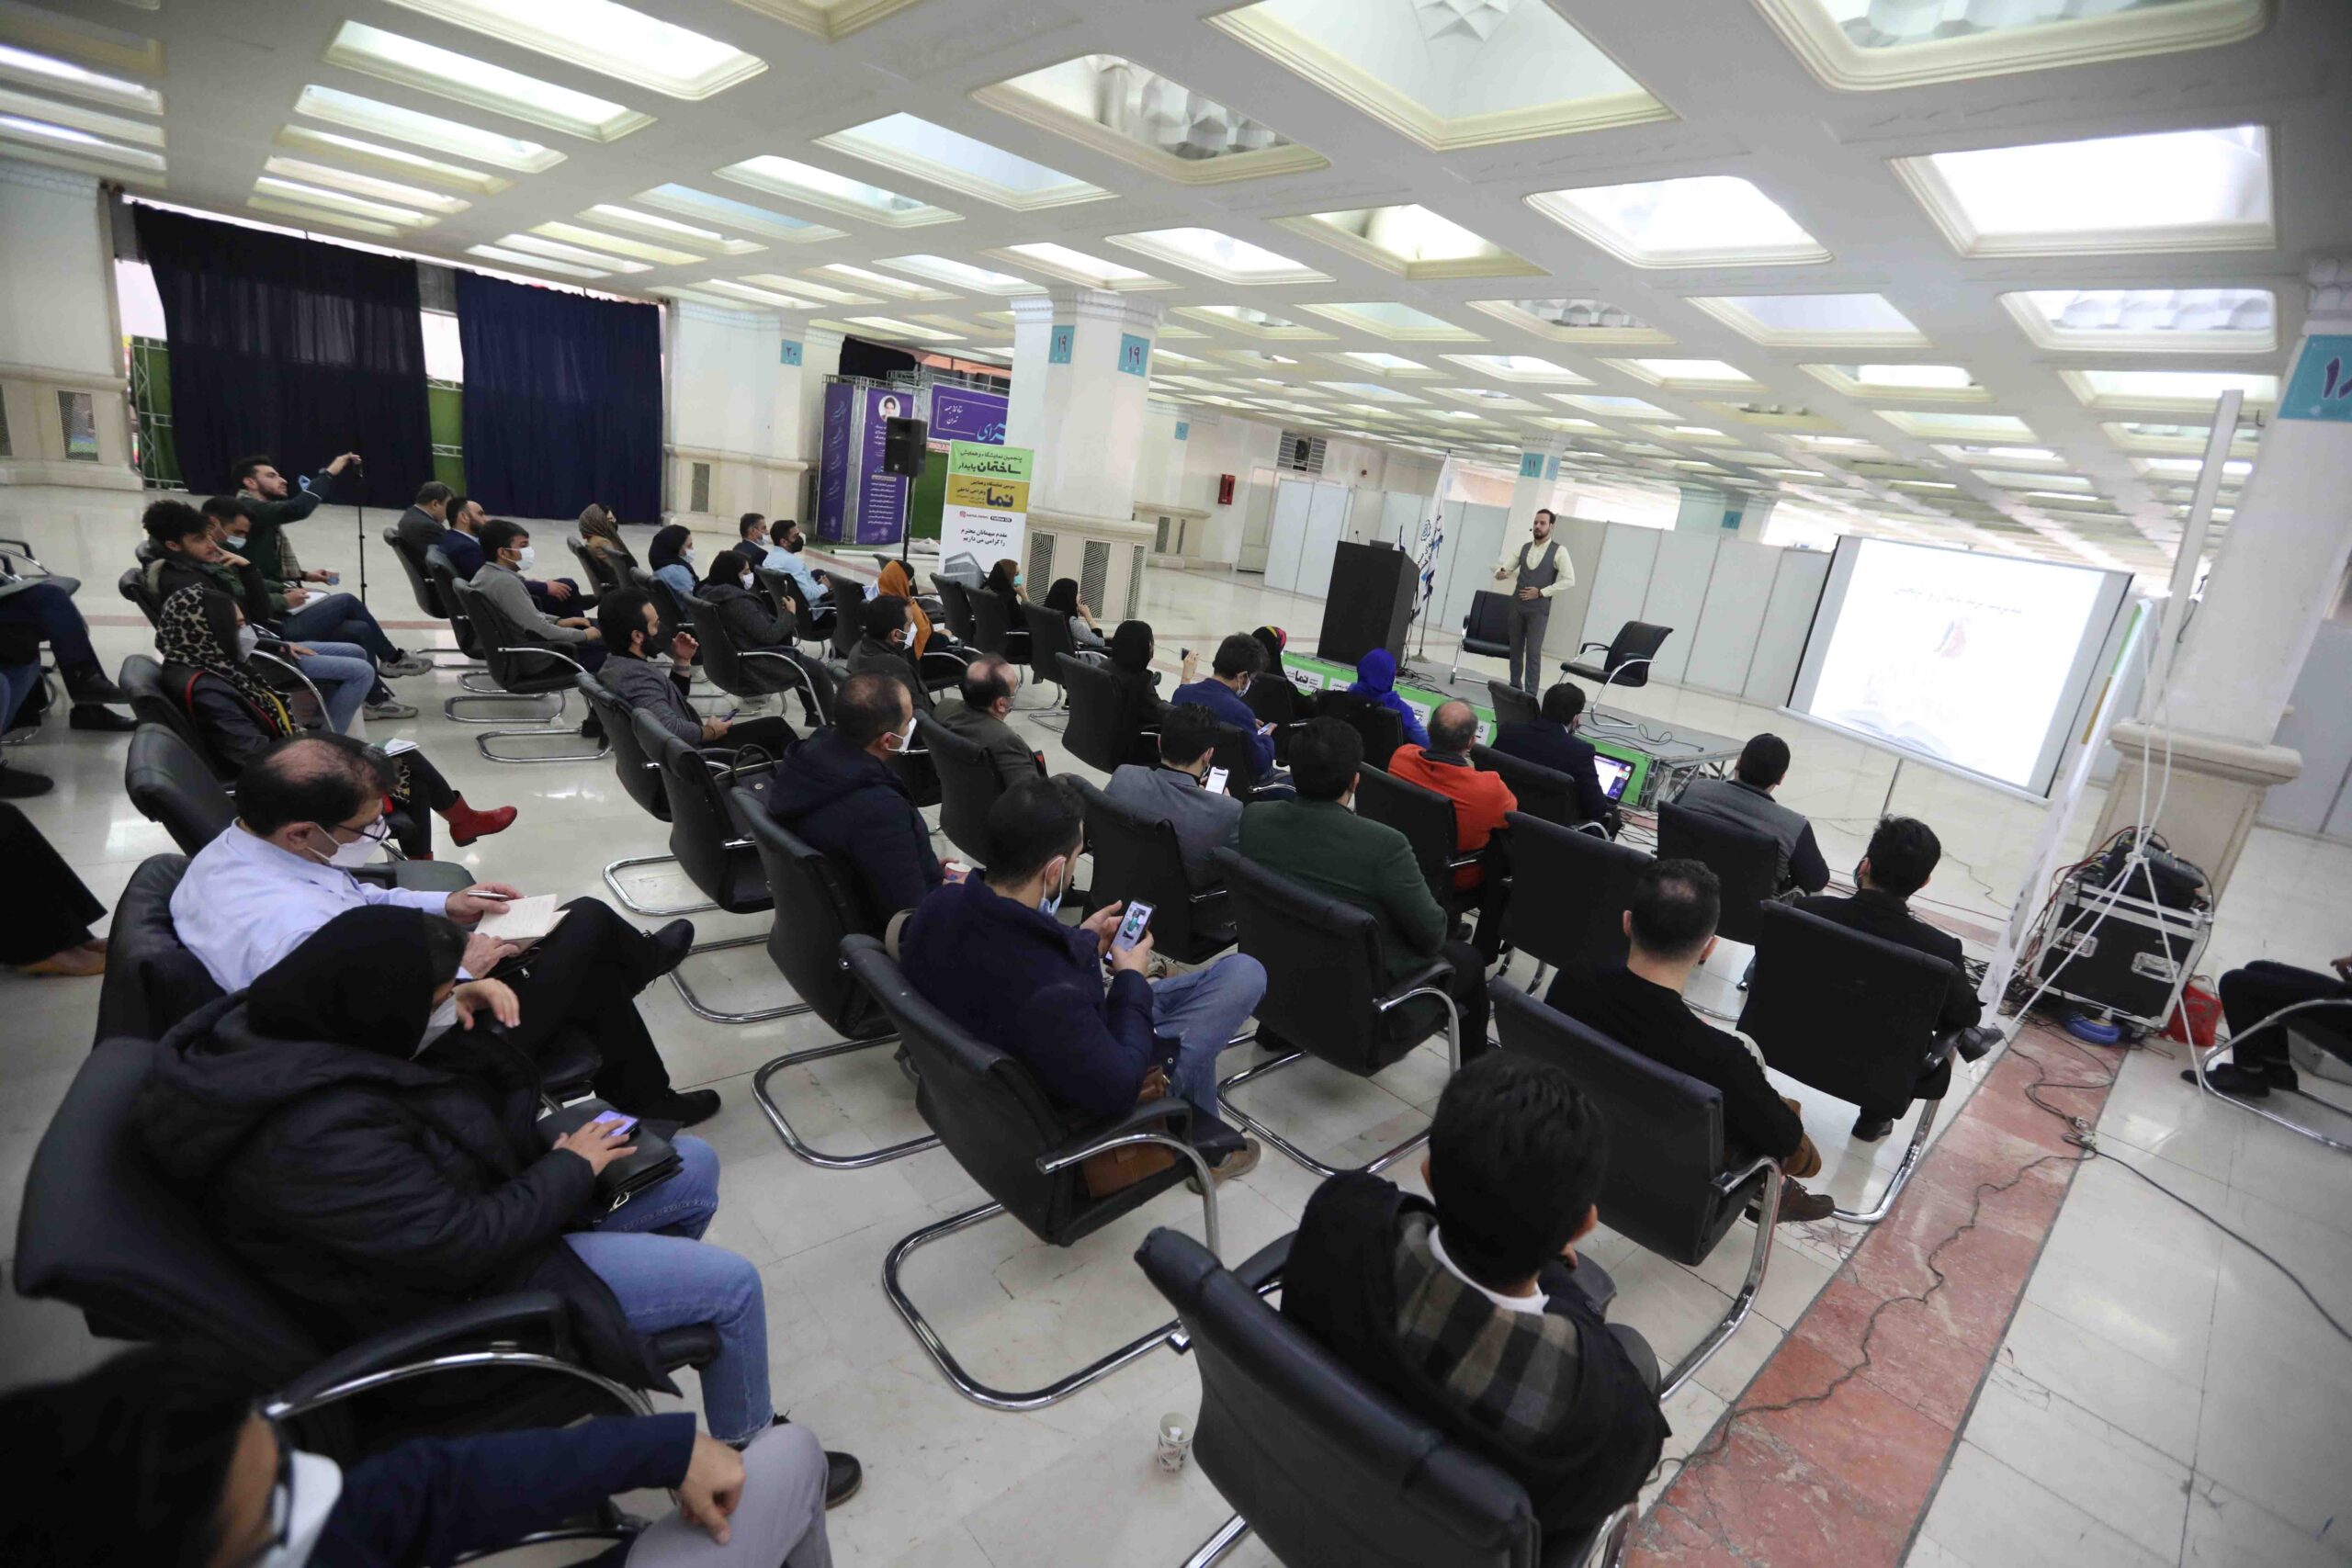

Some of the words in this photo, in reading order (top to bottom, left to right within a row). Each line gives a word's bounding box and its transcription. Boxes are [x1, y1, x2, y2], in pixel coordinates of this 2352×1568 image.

[1128, 344, 1141, 366] ۱۹
[958, 462, 977, 472] پایدار
[977, 460, 1022, 475] ساختمان
[986, 487, 1014, 508] نما
[1295, 670, 1309, 684] نما
